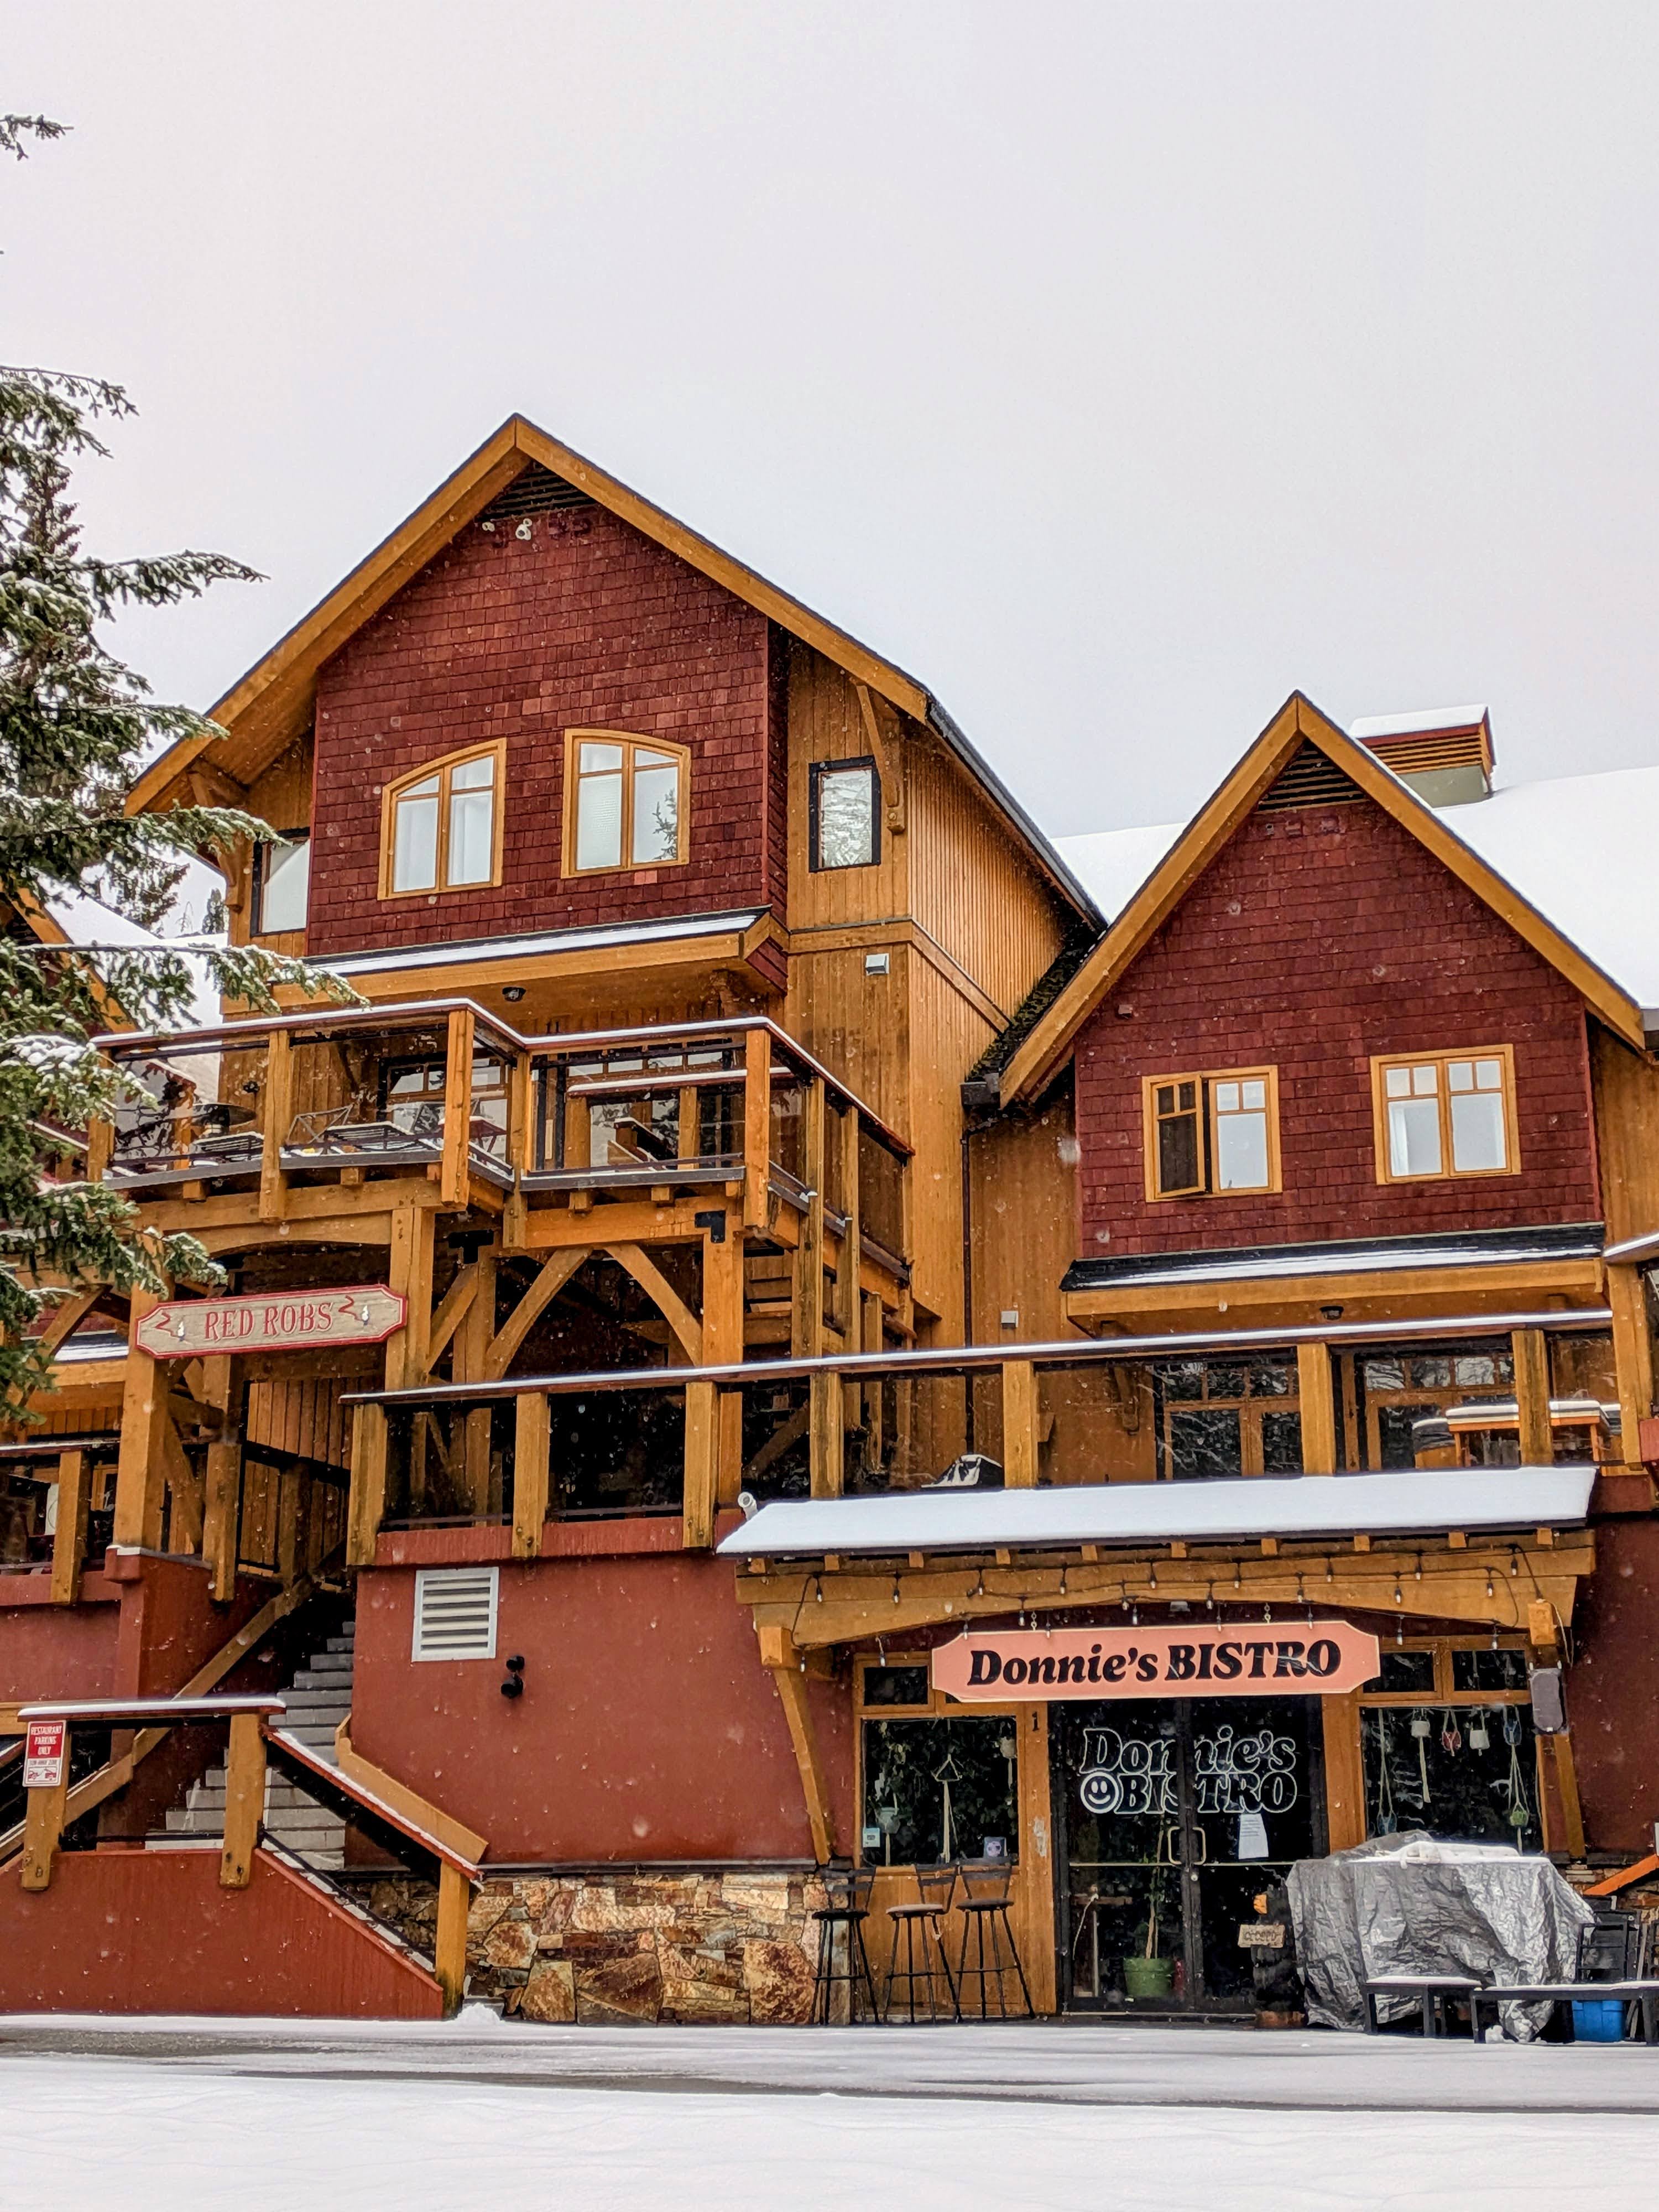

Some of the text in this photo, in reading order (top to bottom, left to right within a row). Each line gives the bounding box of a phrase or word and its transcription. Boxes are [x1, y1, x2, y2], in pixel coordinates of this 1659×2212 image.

[204, 1302, 333, 1342] RED ROBS
[967, 1639, 1342, 1685] Donnie's BISTRO
[1031, 1711, 1040, 1731] 1
